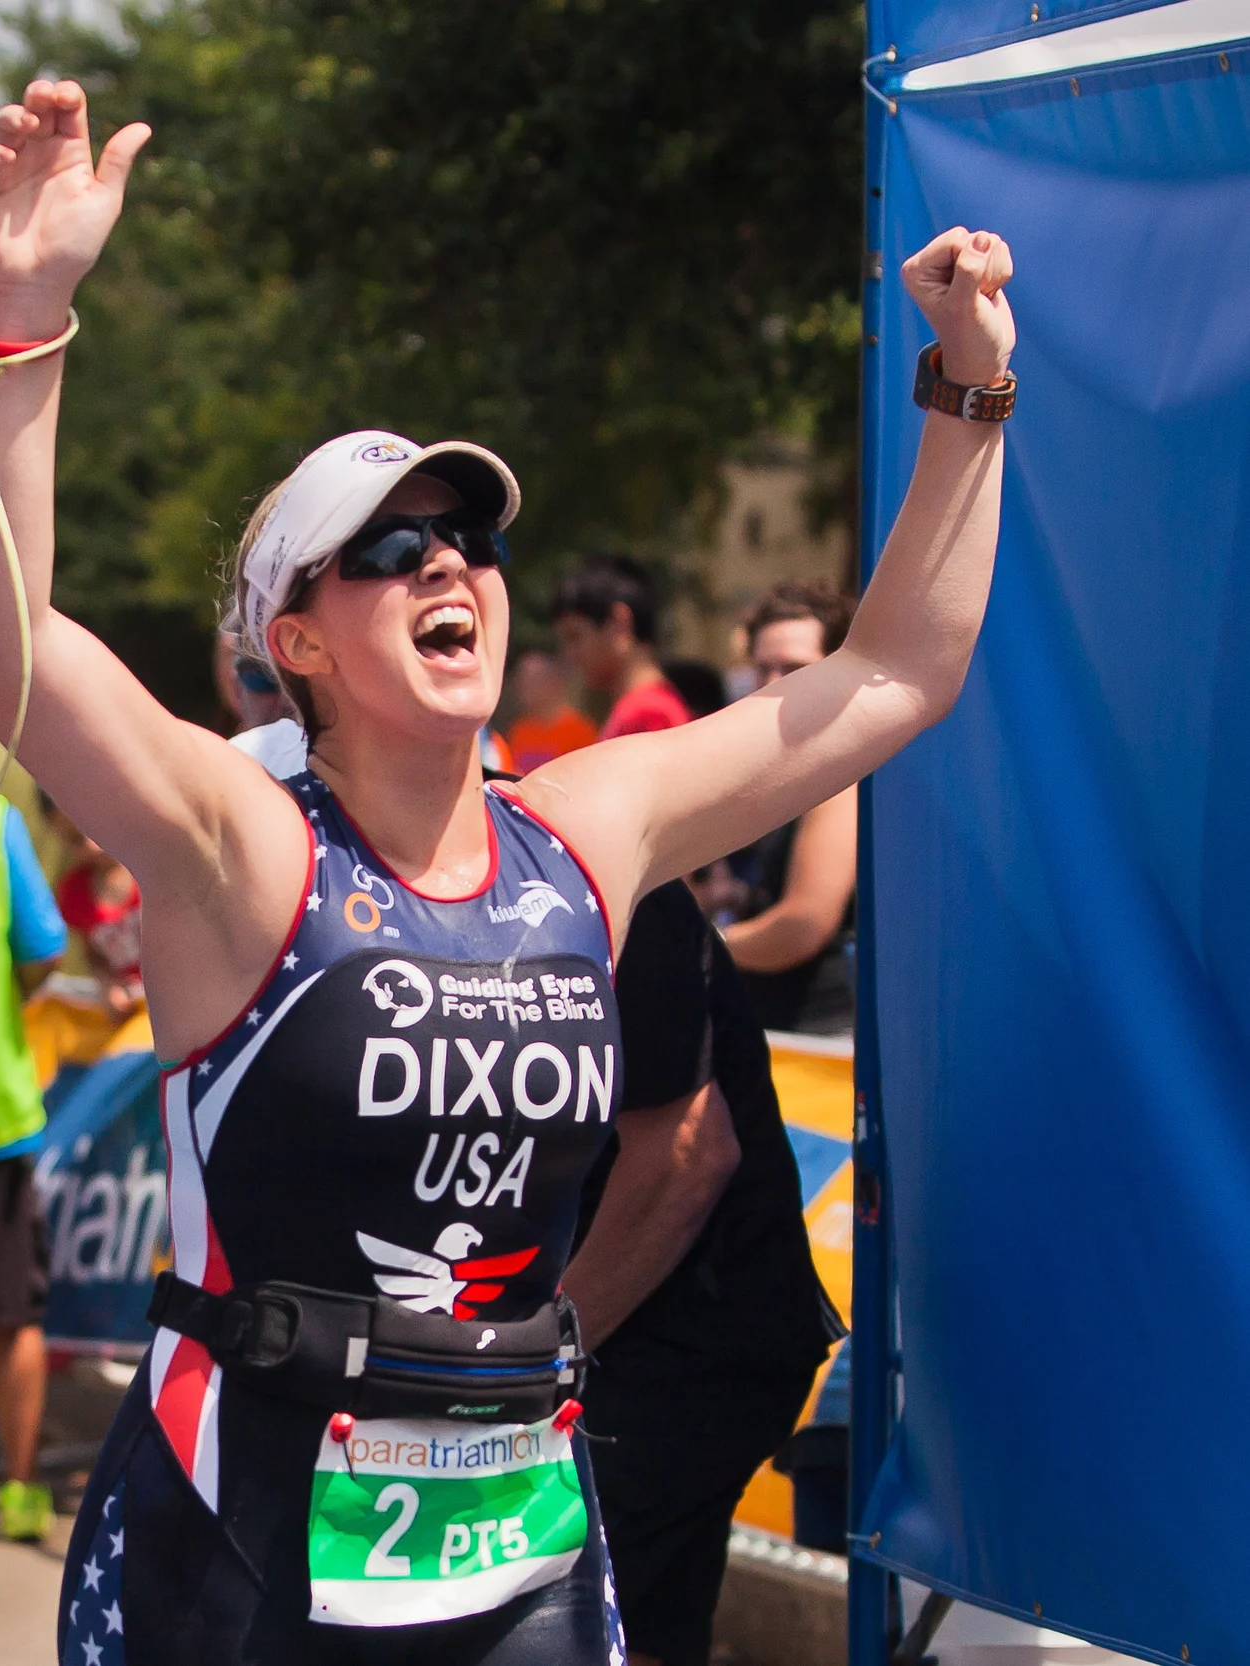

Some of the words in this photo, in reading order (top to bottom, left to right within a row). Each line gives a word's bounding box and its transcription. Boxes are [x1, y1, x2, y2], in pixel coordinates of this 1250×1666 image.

[486, 889, 554, 925] kiwami
[438, 973, 538, 1002] Guiding
[539, 973, 596, 1000] Eyes
[441, 995, 488, 1020] For
[489, 999, 543, 1022] The
[545, 997, 605, 1022] Blind
[357, 1036, 615, 1123] DIXON
[414, 1131, 536, 1208] USA
[350, 1431, 541, 1469] paratriathlon
[363, 1481, 420, 1578] 2
[438, 1515, 530, 1577] PT5
